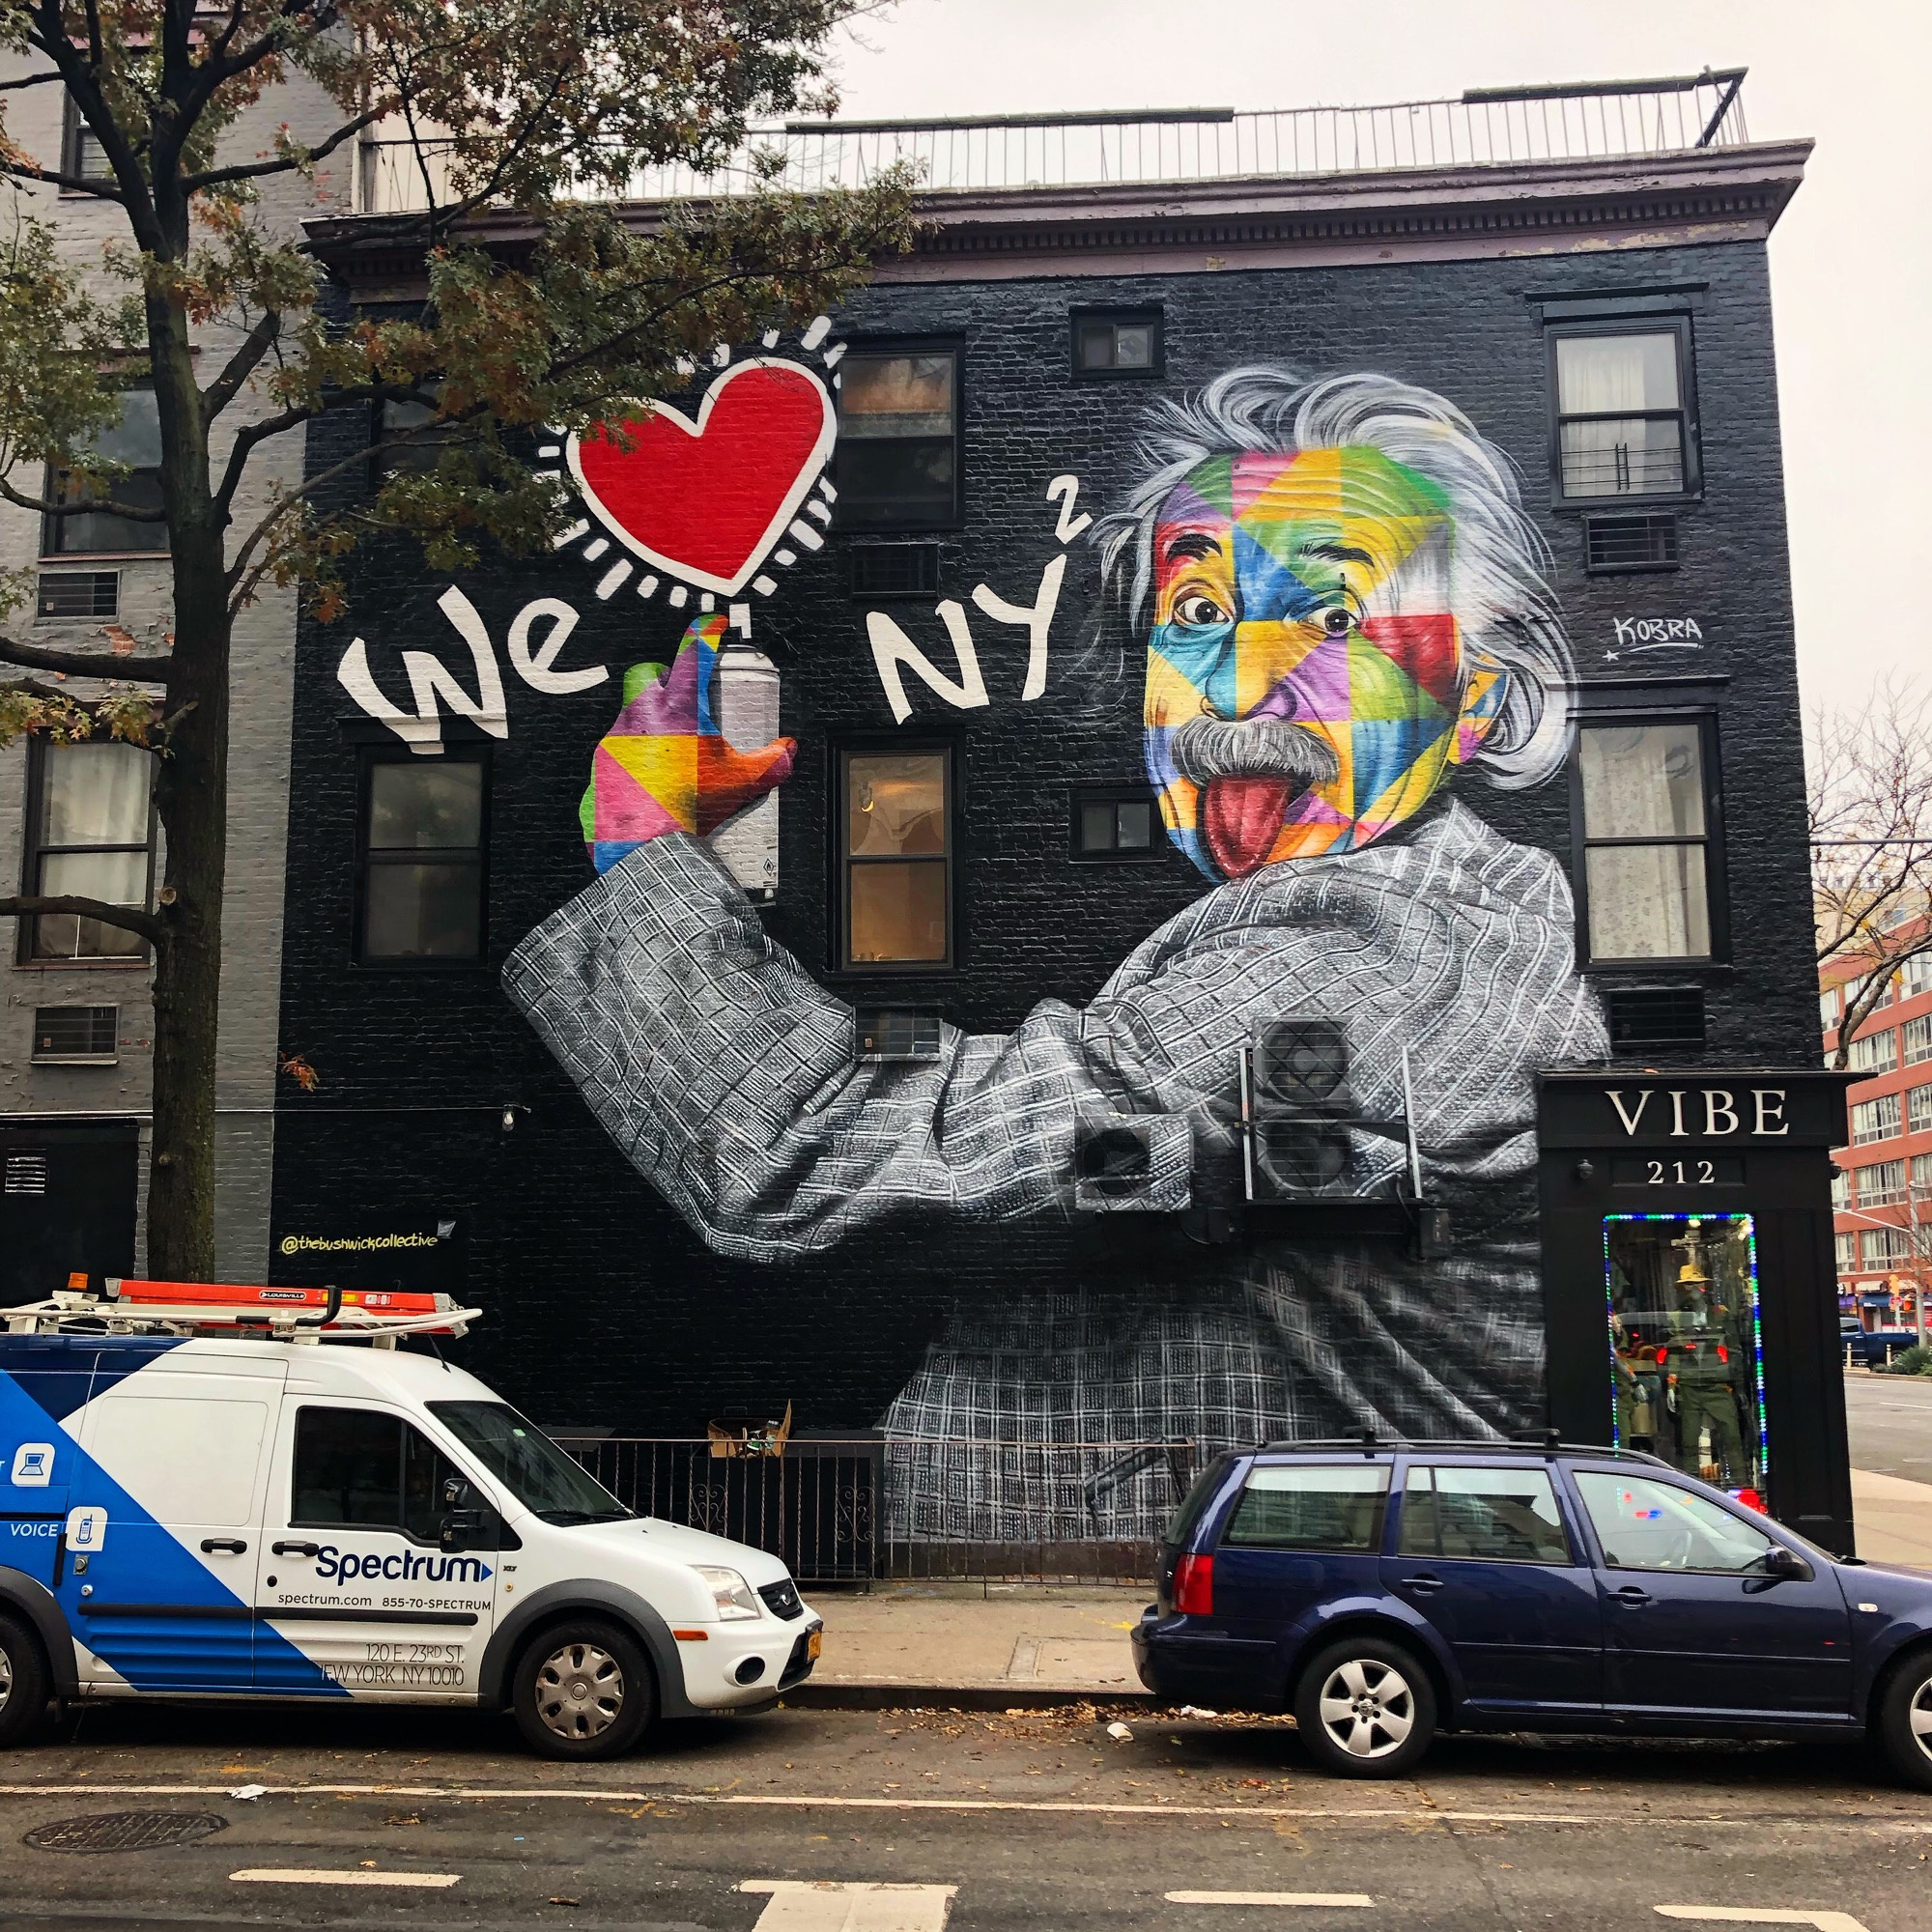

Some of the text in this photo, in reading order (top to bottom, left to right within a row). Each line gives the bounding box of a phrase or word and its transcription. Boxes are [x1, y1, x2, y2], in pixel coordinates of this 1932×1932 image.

[1613, 616, 1703, 645] KOBRA
[336, 585, 610, 754] We
[1605, 1090, 1790, 1137] VIBE
[1646, 1160, 1716, 1185] 212
[281, 1232, 439, 1256] @thebushwickcollective
[11, 1522, 59, 1537] VOICE
[315, 1546, 481, 1586] Spectrum
[277, 1594, 373, 1607] spectrum.com
[382, 1597, 492, 1611] 855-70-SPECTRUM
[365, 1643, 465, 1663] 120 E. 23RD ST.
[353, 1664, 396, 1684] YORK
[402, 1666, 425, 1685] NY
[427, 1666, 465, 1687] 10010
